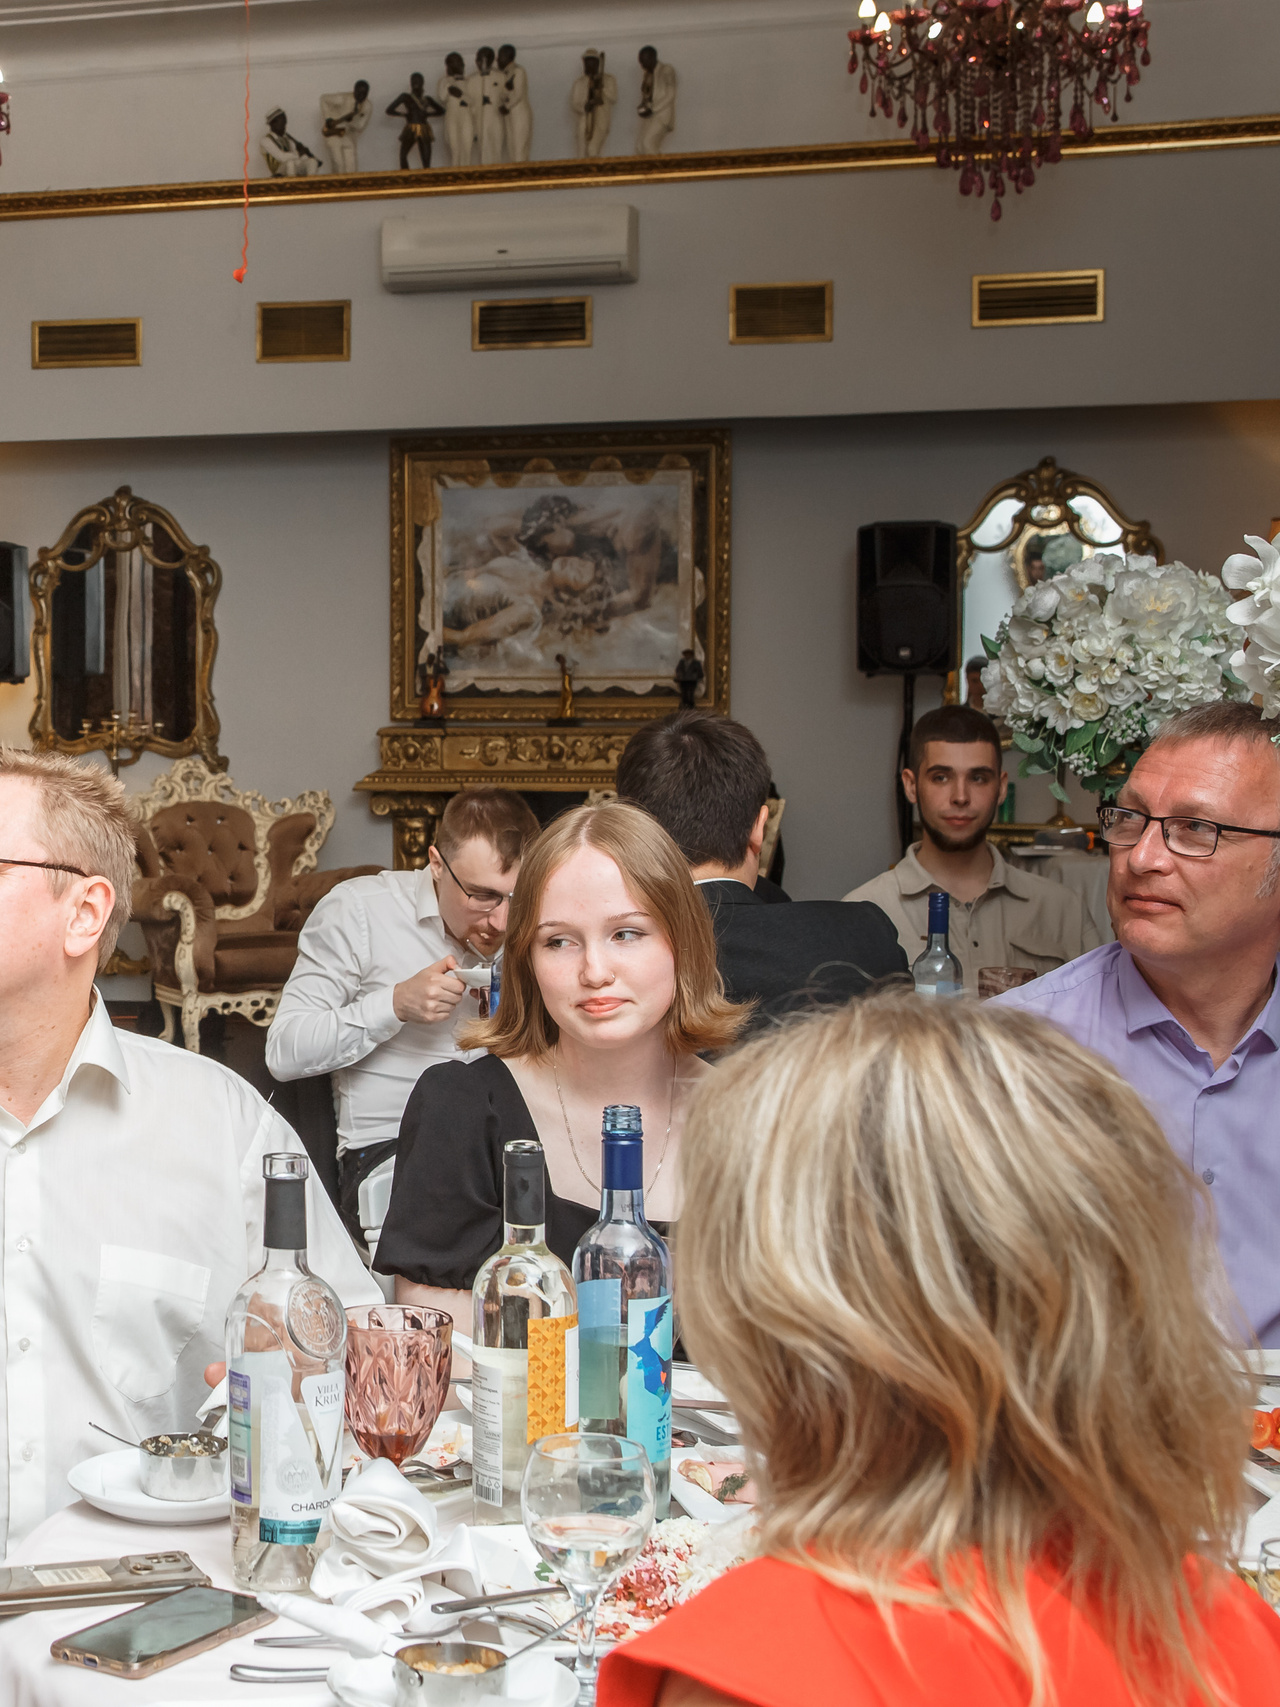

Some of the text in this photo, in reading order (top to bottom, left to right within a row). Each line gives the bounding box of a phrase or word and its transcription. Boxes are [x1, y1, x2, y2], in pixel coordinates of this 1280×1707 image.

[317, 1383, 339, 1395] VILLA
[315, 1393, 340, 1407] KRIM
[291, 1496, 337, 1513] CHARD
